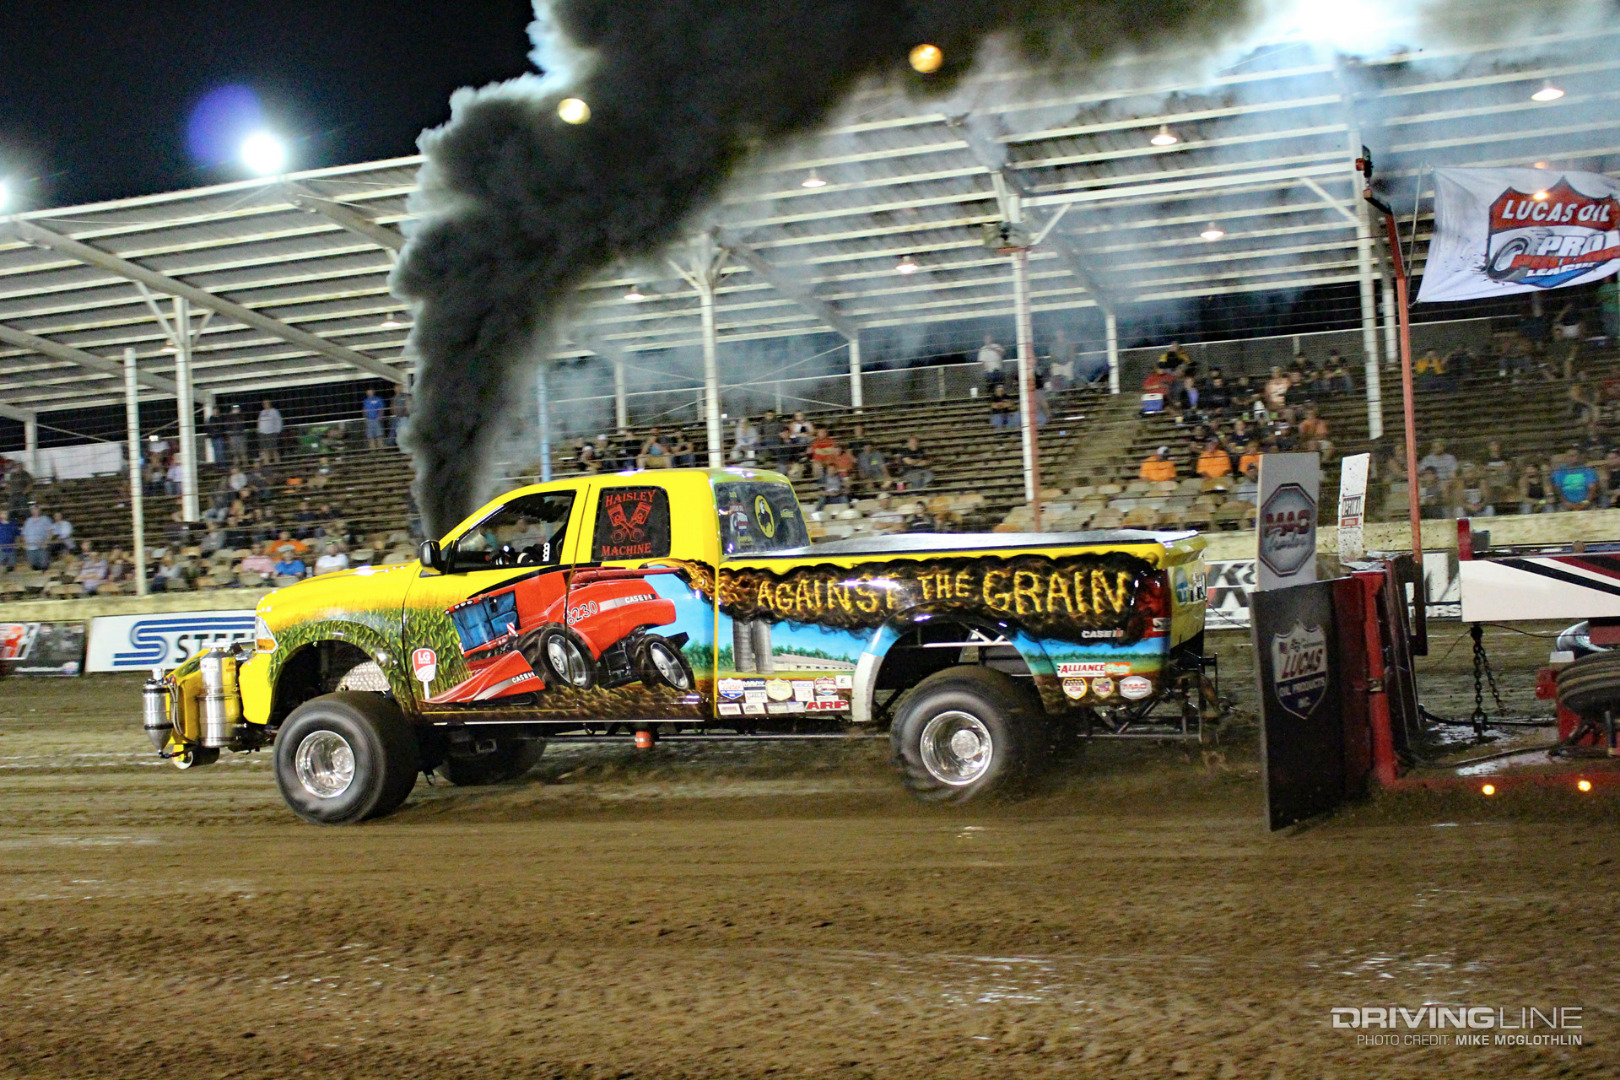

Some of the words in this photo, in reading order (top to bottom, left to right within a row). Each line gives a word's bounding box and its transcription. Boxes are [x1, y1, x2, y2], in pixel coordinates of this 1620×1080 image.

[1502, 199, 1578, 222] LUCAS
[1577, 204, 1610, 222] OIL
[1536, 233, 1605, 257] PRO
[605, 489, 656, 507] HAISLEY
[602, 543, 651, 557] MACHINE
[757, 572, 903, 613] AGAINST
[917, 574, 971, 600] THE
[982, 569, 1127, 615] GRAIN
[1082, 629, 1112, 638] CASE
[418, 651, 431, 661] LG
[1281, 648, 1324, 679] LUCAS
[1060, 664, 1105, 673] ALLIANCE
[806, 700, 849, 710] ARP
